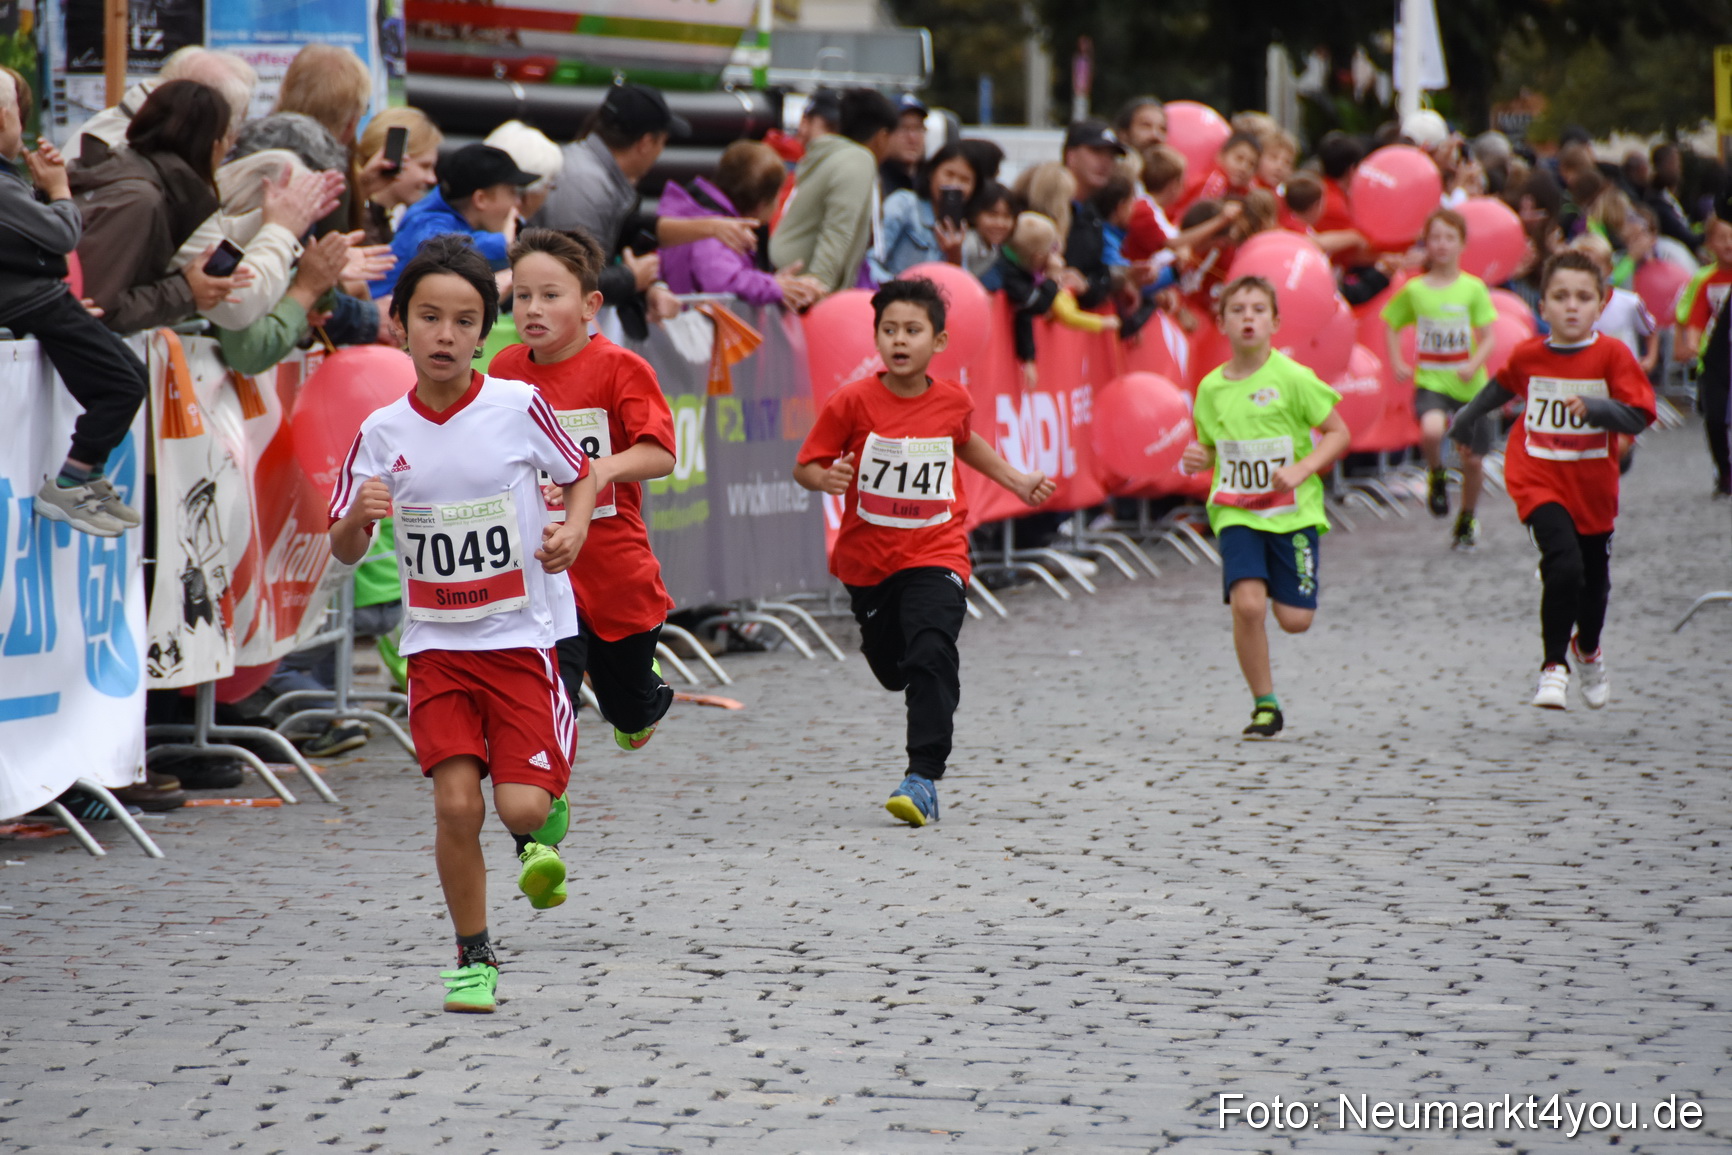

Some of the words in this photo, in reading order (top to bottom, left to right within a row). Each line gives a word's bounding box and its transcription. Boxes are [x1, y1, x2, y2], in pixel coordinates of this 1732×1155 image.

[556, 412, 599, 428] OCK
[908, 441, 948, 454] BOCK
[391, 465, 411, 473] adidas
[872, 458, 947, 495] 7147
[441, 500, 505, 521] BOCK
[893, 502, 920, 516] Luis
[401, 516, 435, 524] NeuerMarkt
[407, 525, 511, 577] 7049
[435, 588, 489, 606] Simon
